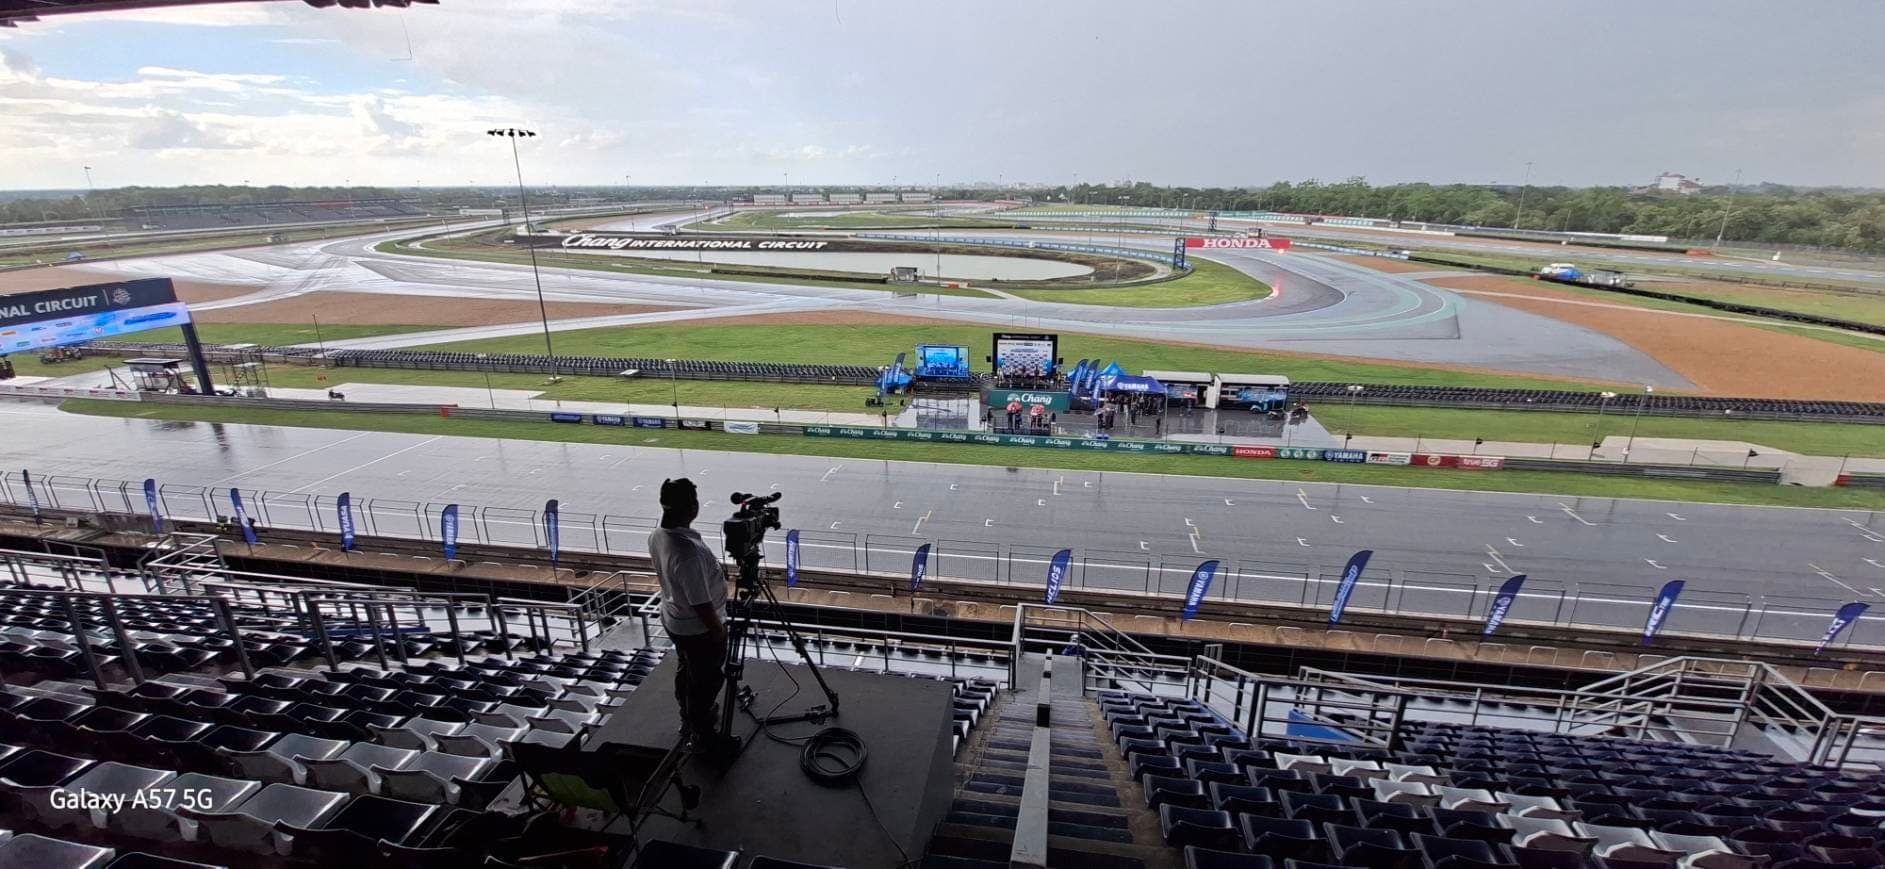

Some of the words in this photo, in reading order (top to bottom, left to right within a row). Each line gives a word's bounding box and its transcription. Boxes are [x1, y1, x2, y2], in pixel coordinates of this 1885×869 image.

[562, 233, 633, 249] Chang
[630, 240, 751, 248] INTERNATIONAL
[1203, 239, 1272, 248] HONDA
[34, 295, 98, 314] CIRCUIT
[1021, 393, 1052, 405] Chang
[1235, 447, 1271, 456] HONDA
[1333, 452, 1363, 460] YAMAHA
[343, 506, 352, 533] YUASA
[1189, 580, 1206, 605] YAMAHA
